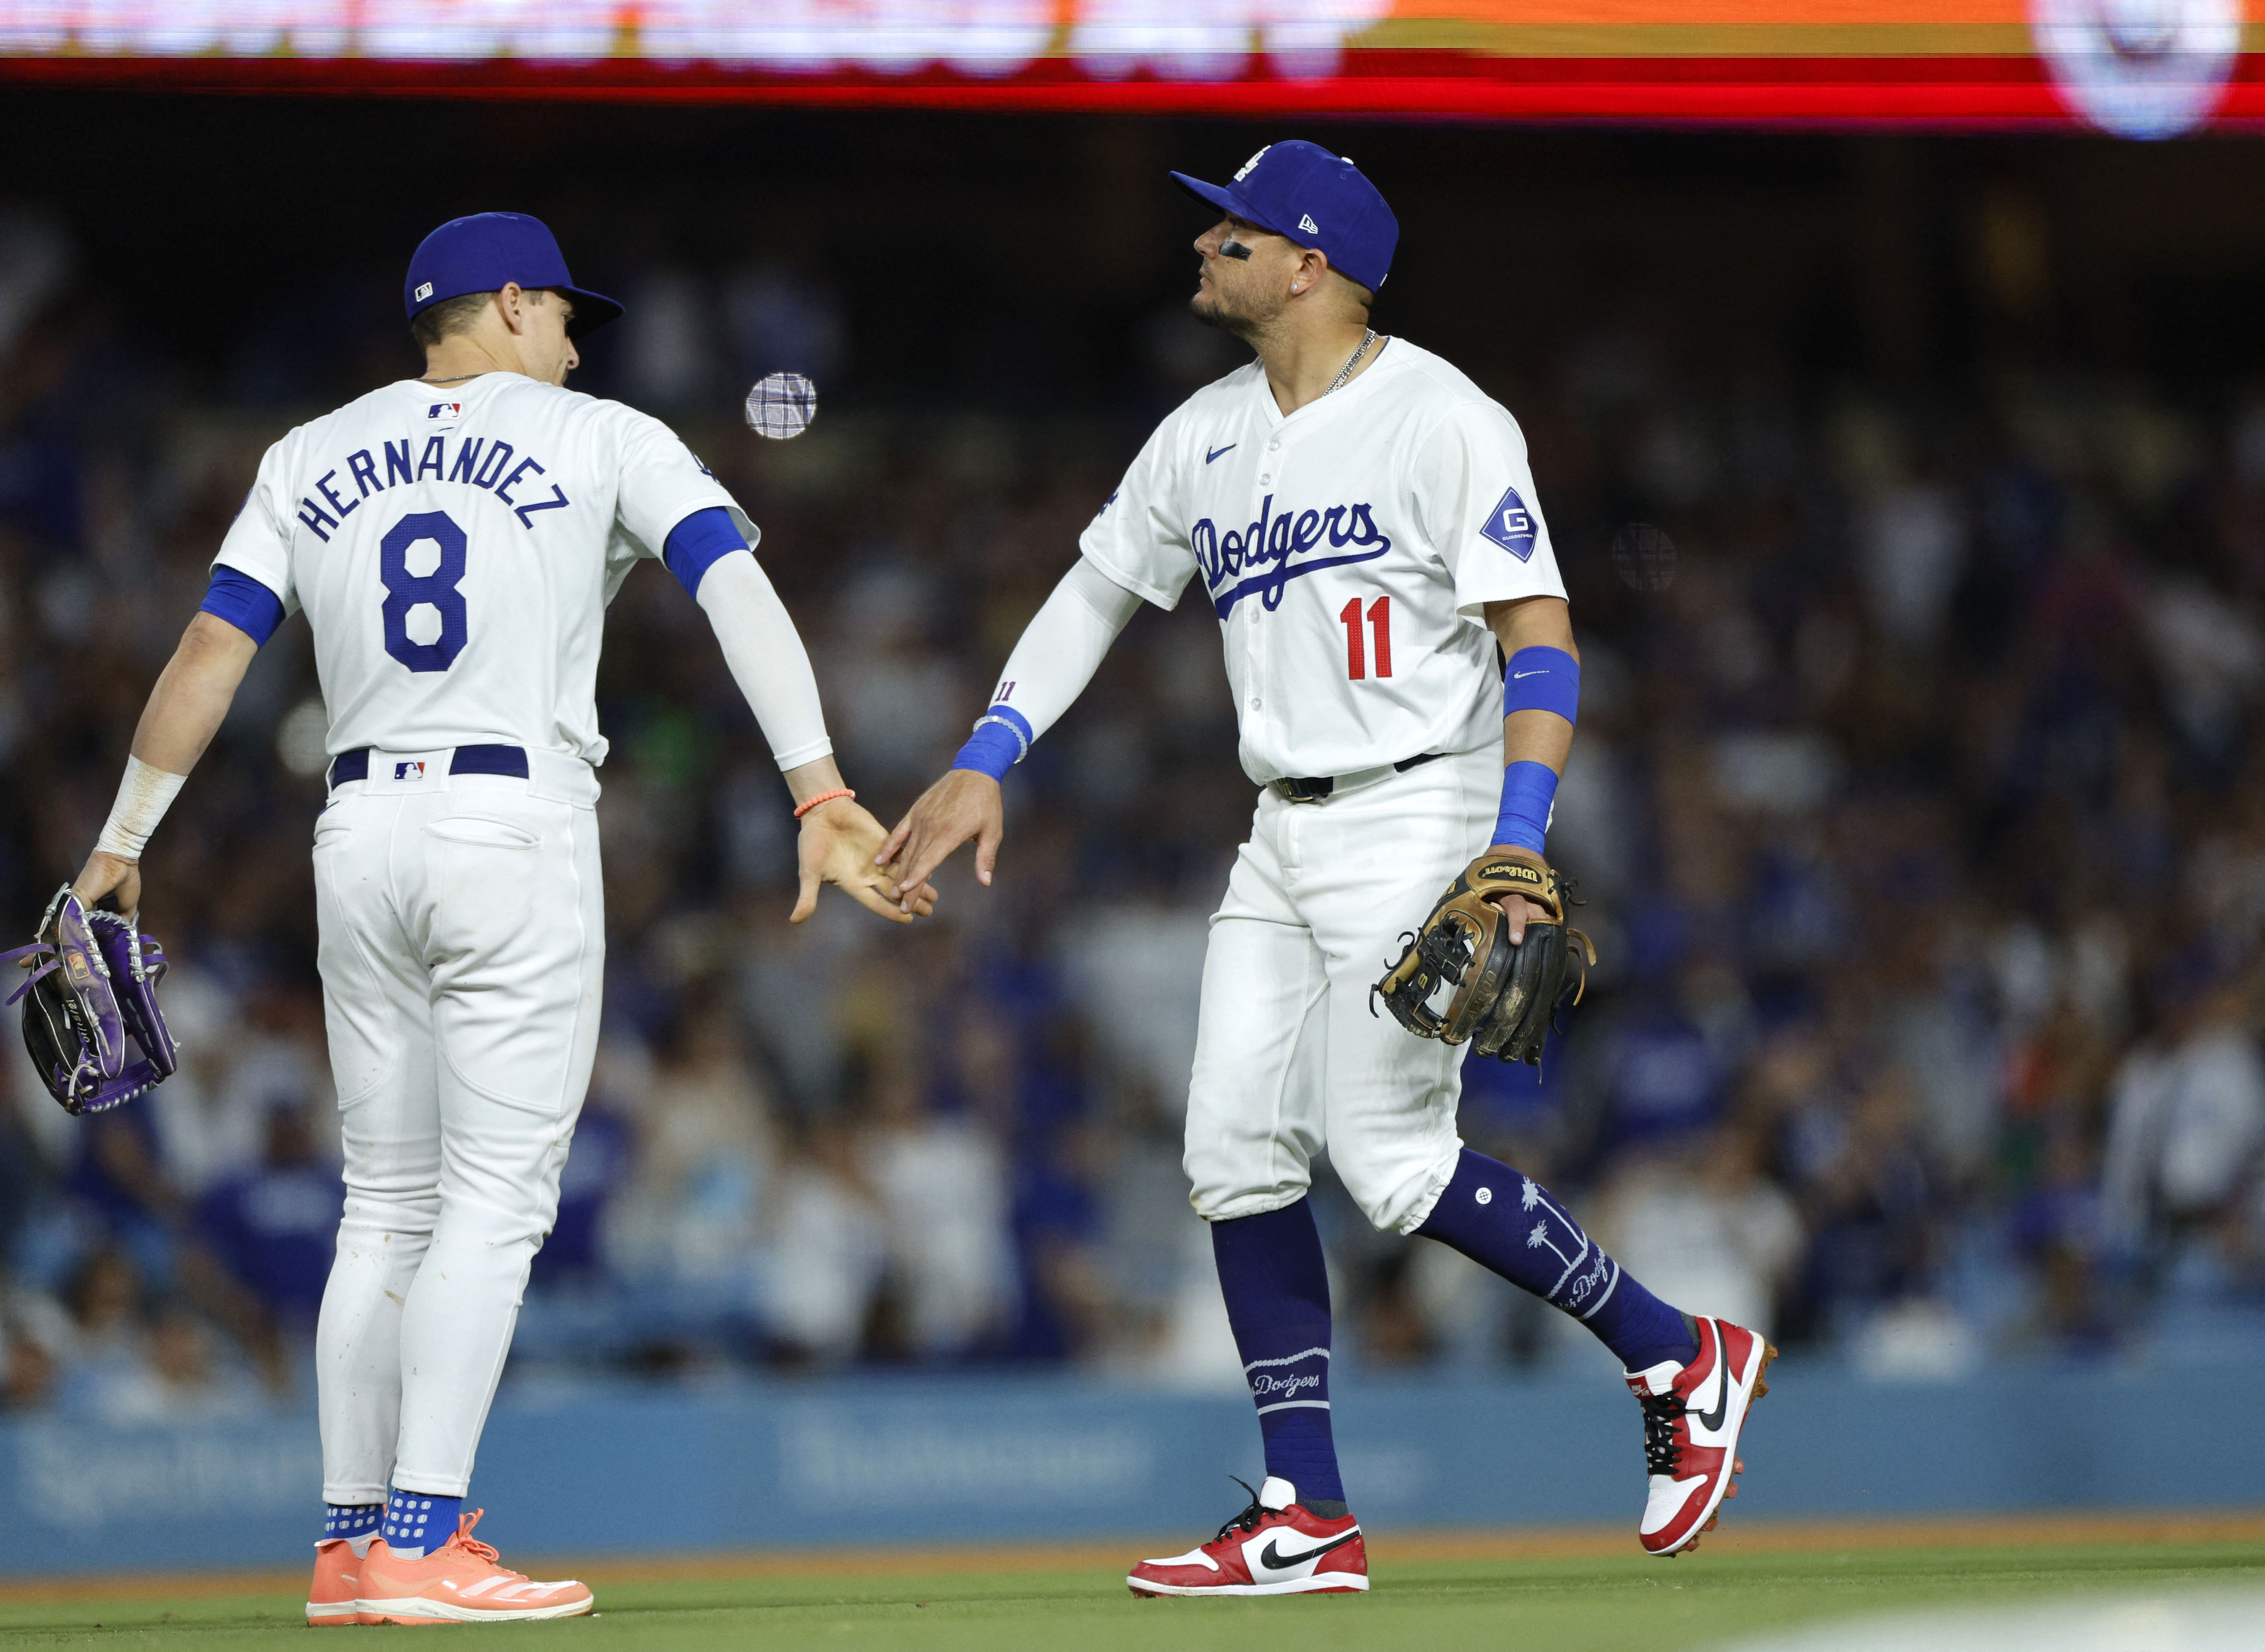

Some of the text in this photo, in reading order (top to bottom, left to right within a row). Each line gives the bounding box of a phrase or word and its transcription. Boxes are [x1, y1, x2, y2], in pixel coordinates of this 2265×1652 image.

[1503, 508, 1529, 532] G
[1192, 494, 1391, 622] Dodgers
[380, 510, 467, 673] 8
[1340, 596, 1392, 680] 11
[994, 681, 1016, 702] 11
[1484, 866, 1538, 883] Wilson
[1254, 1373, 1319, 1398] Dodgers
